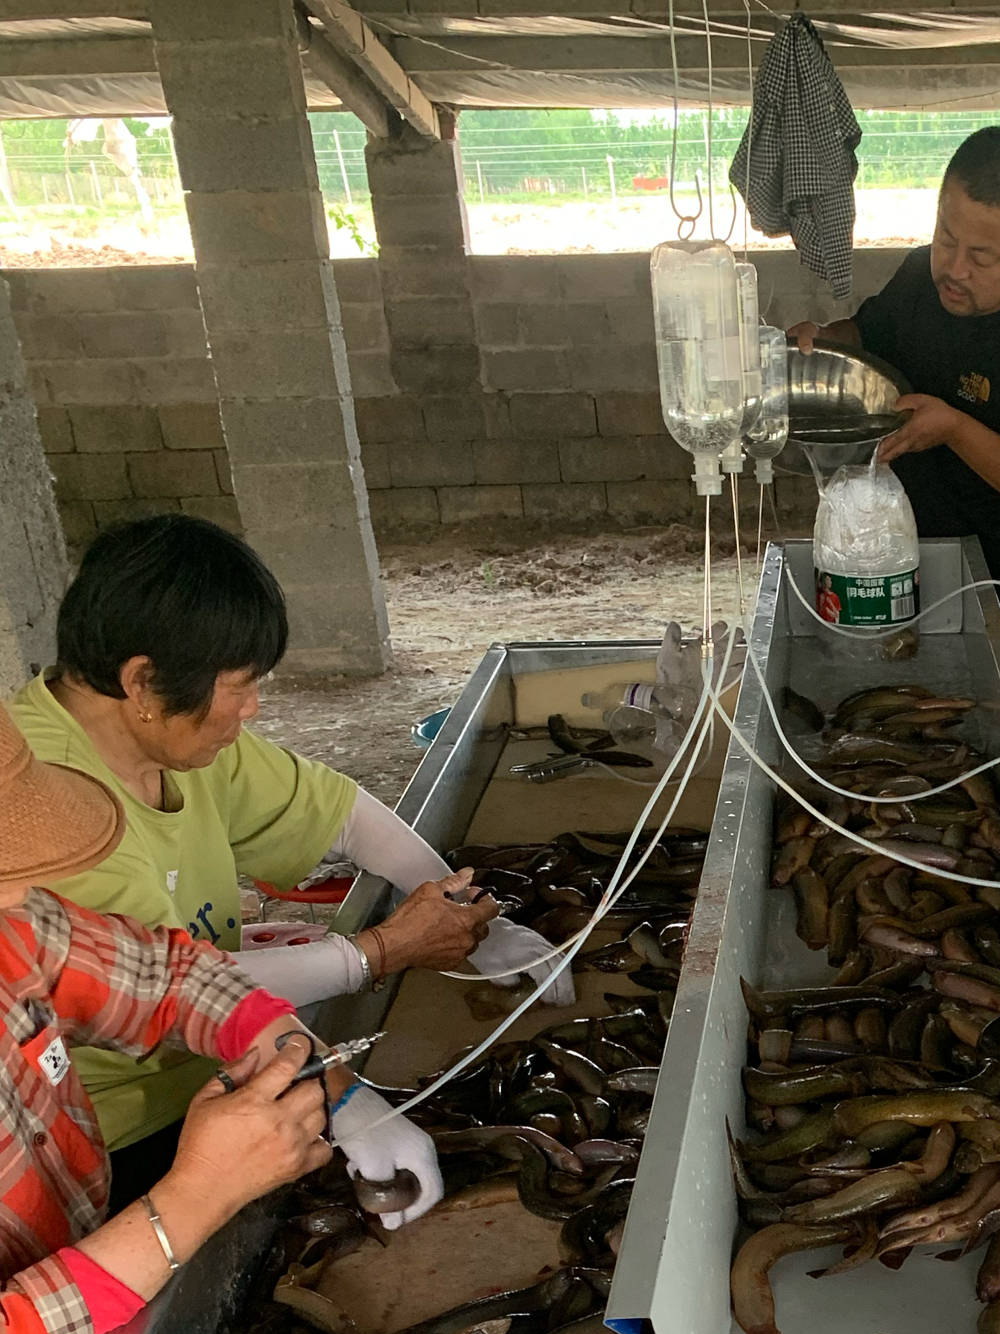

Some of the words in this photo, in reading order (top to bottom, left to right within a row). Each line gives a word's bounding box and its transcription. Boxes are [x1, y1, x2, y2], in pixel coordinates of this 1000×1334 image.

[970, 371, 984, 383] THE
[855, 578, 885, 587] 中国国家
